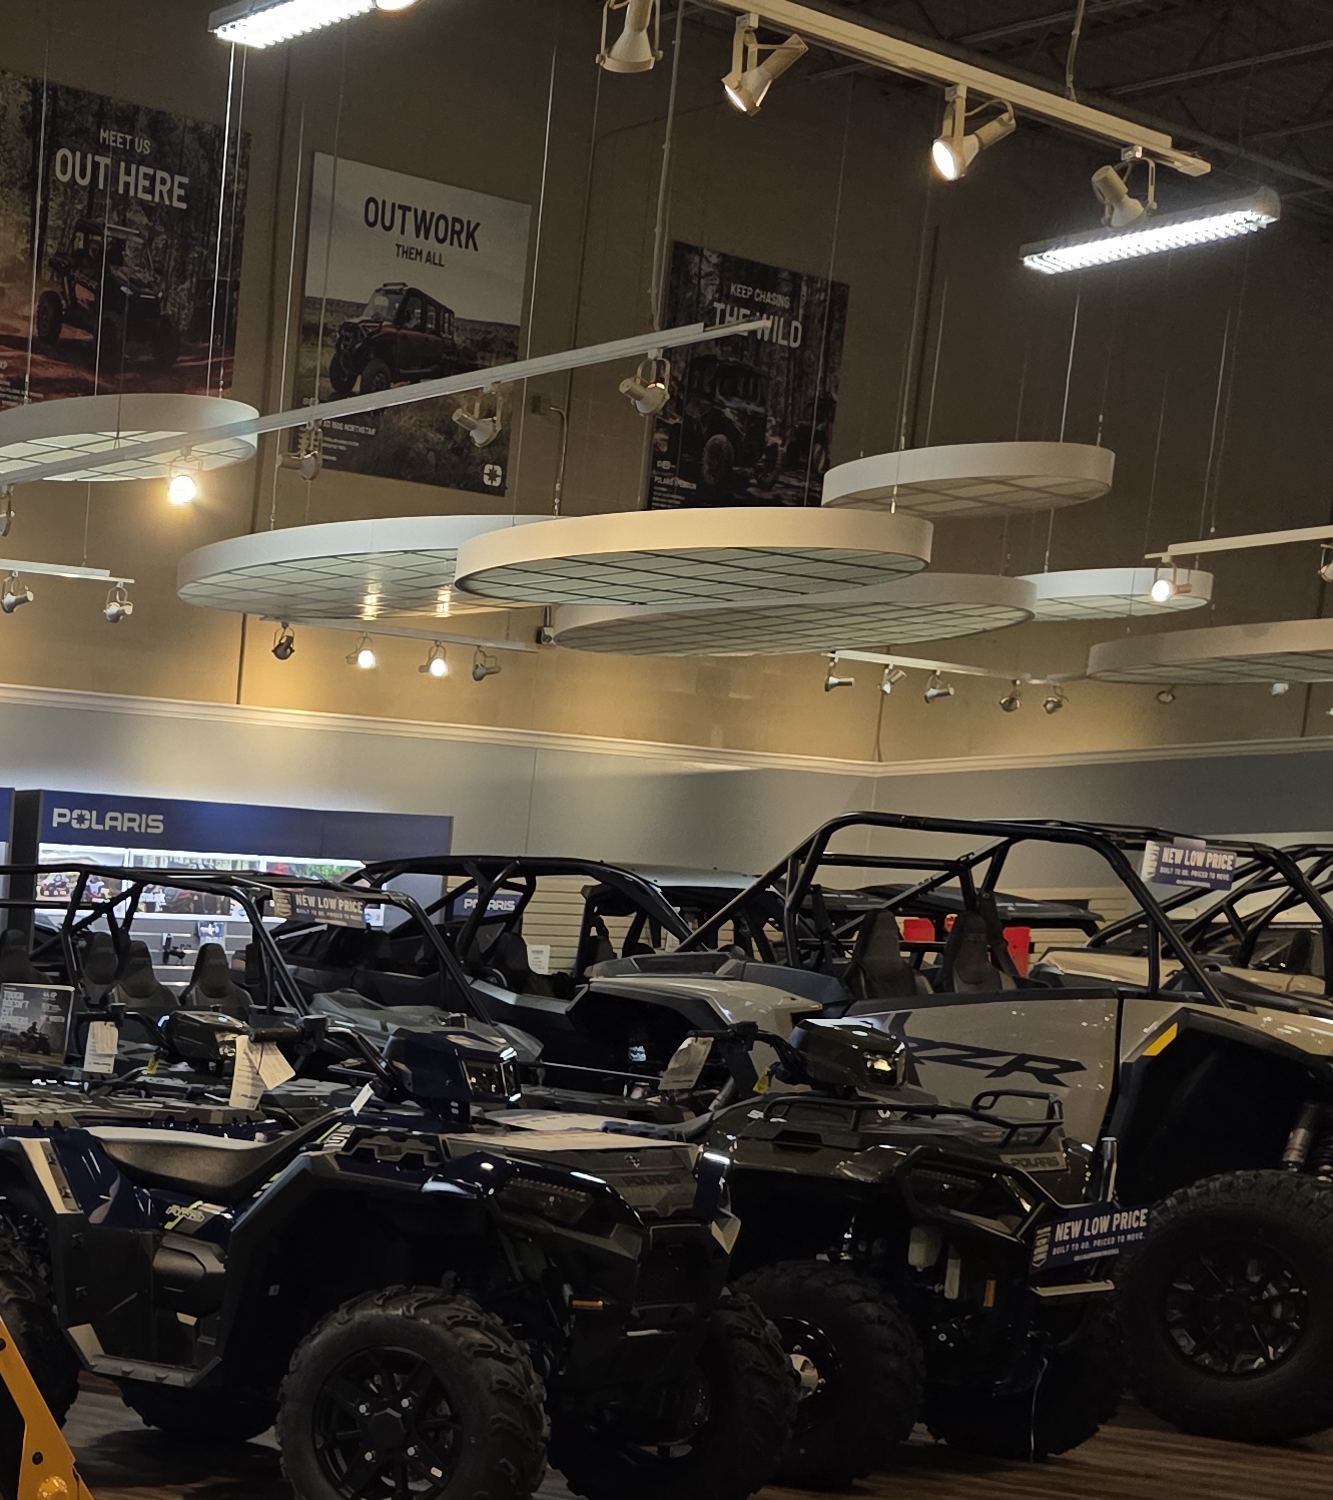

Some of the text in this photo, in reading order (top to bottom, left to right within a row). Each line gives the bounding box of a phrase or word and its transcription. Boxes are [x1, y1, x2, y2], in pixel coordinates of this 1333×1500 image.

[99, 127, 151, 155] MEET US
[55, 147, 189, 210] OUT HERE
[364, 196, 481, 251] OUTWORK
[395, 243, 445, 268] THEM ALL
[730, 283, 791, 310] KEEP CHASING
[713, 303, 803, 348] THE WILD
[52, 807, 165, 835] POLARIS
[1162, 847, 1235, 871] NEW LOW PRICE
[295, 894, 363, 913] NEW LOW PRICE
[464, 898, 515, 911] PARIS
[1010, 1155, 1059, 1168] POLARIS
[1054, 1208, 1149, 1242] NEW LOW PRICE
[1052, 1245, 1070, 1256] BUILT
[1071, 1243, 1079, 1252] TO
[1093, 1236, 1116, 1248] PRICED
[1117, 1234, 1125, 1244] TO
[1126, 1231, 1146, 1242] MOVE.
